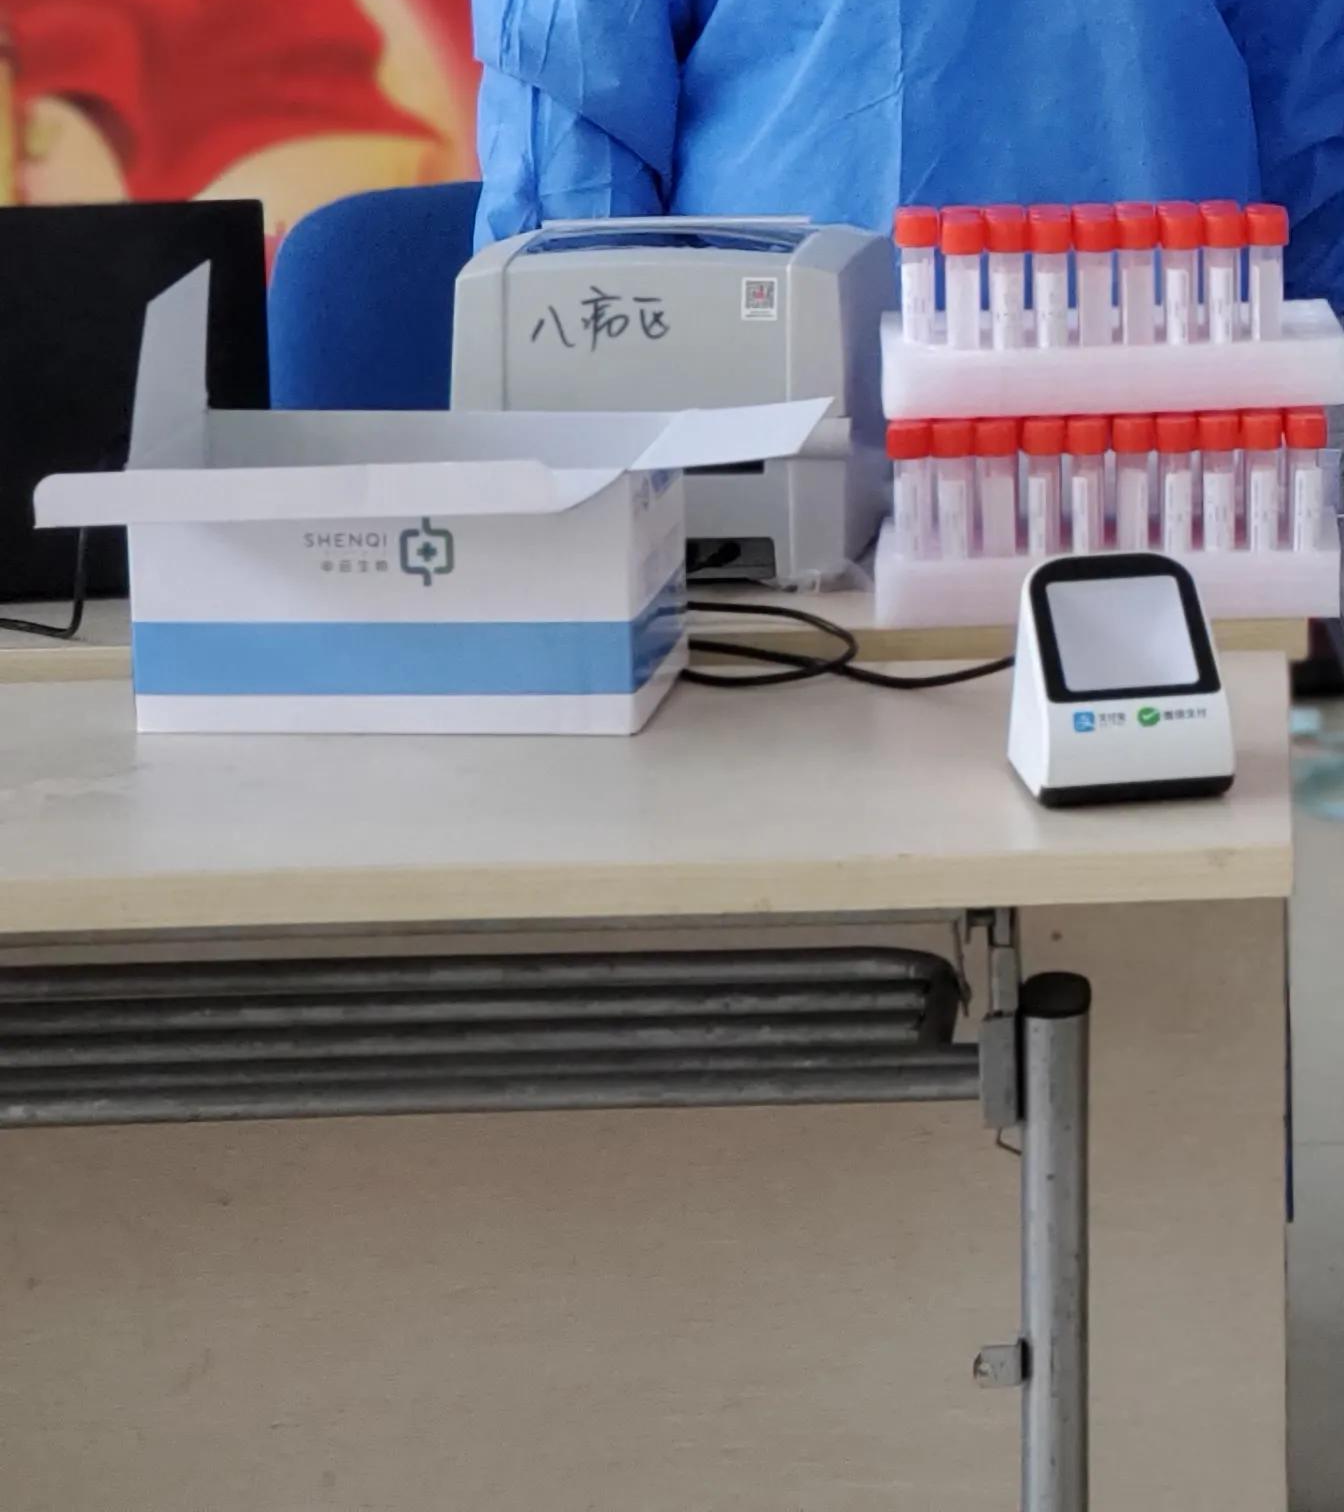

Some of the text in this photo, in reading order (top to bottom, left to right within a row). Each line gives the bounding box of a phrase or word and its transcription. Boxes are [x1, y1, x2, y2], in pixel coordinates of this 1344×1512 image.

[531, 285, 670, 352] 八病区
[303, 531, 388, 549] SHENQI
